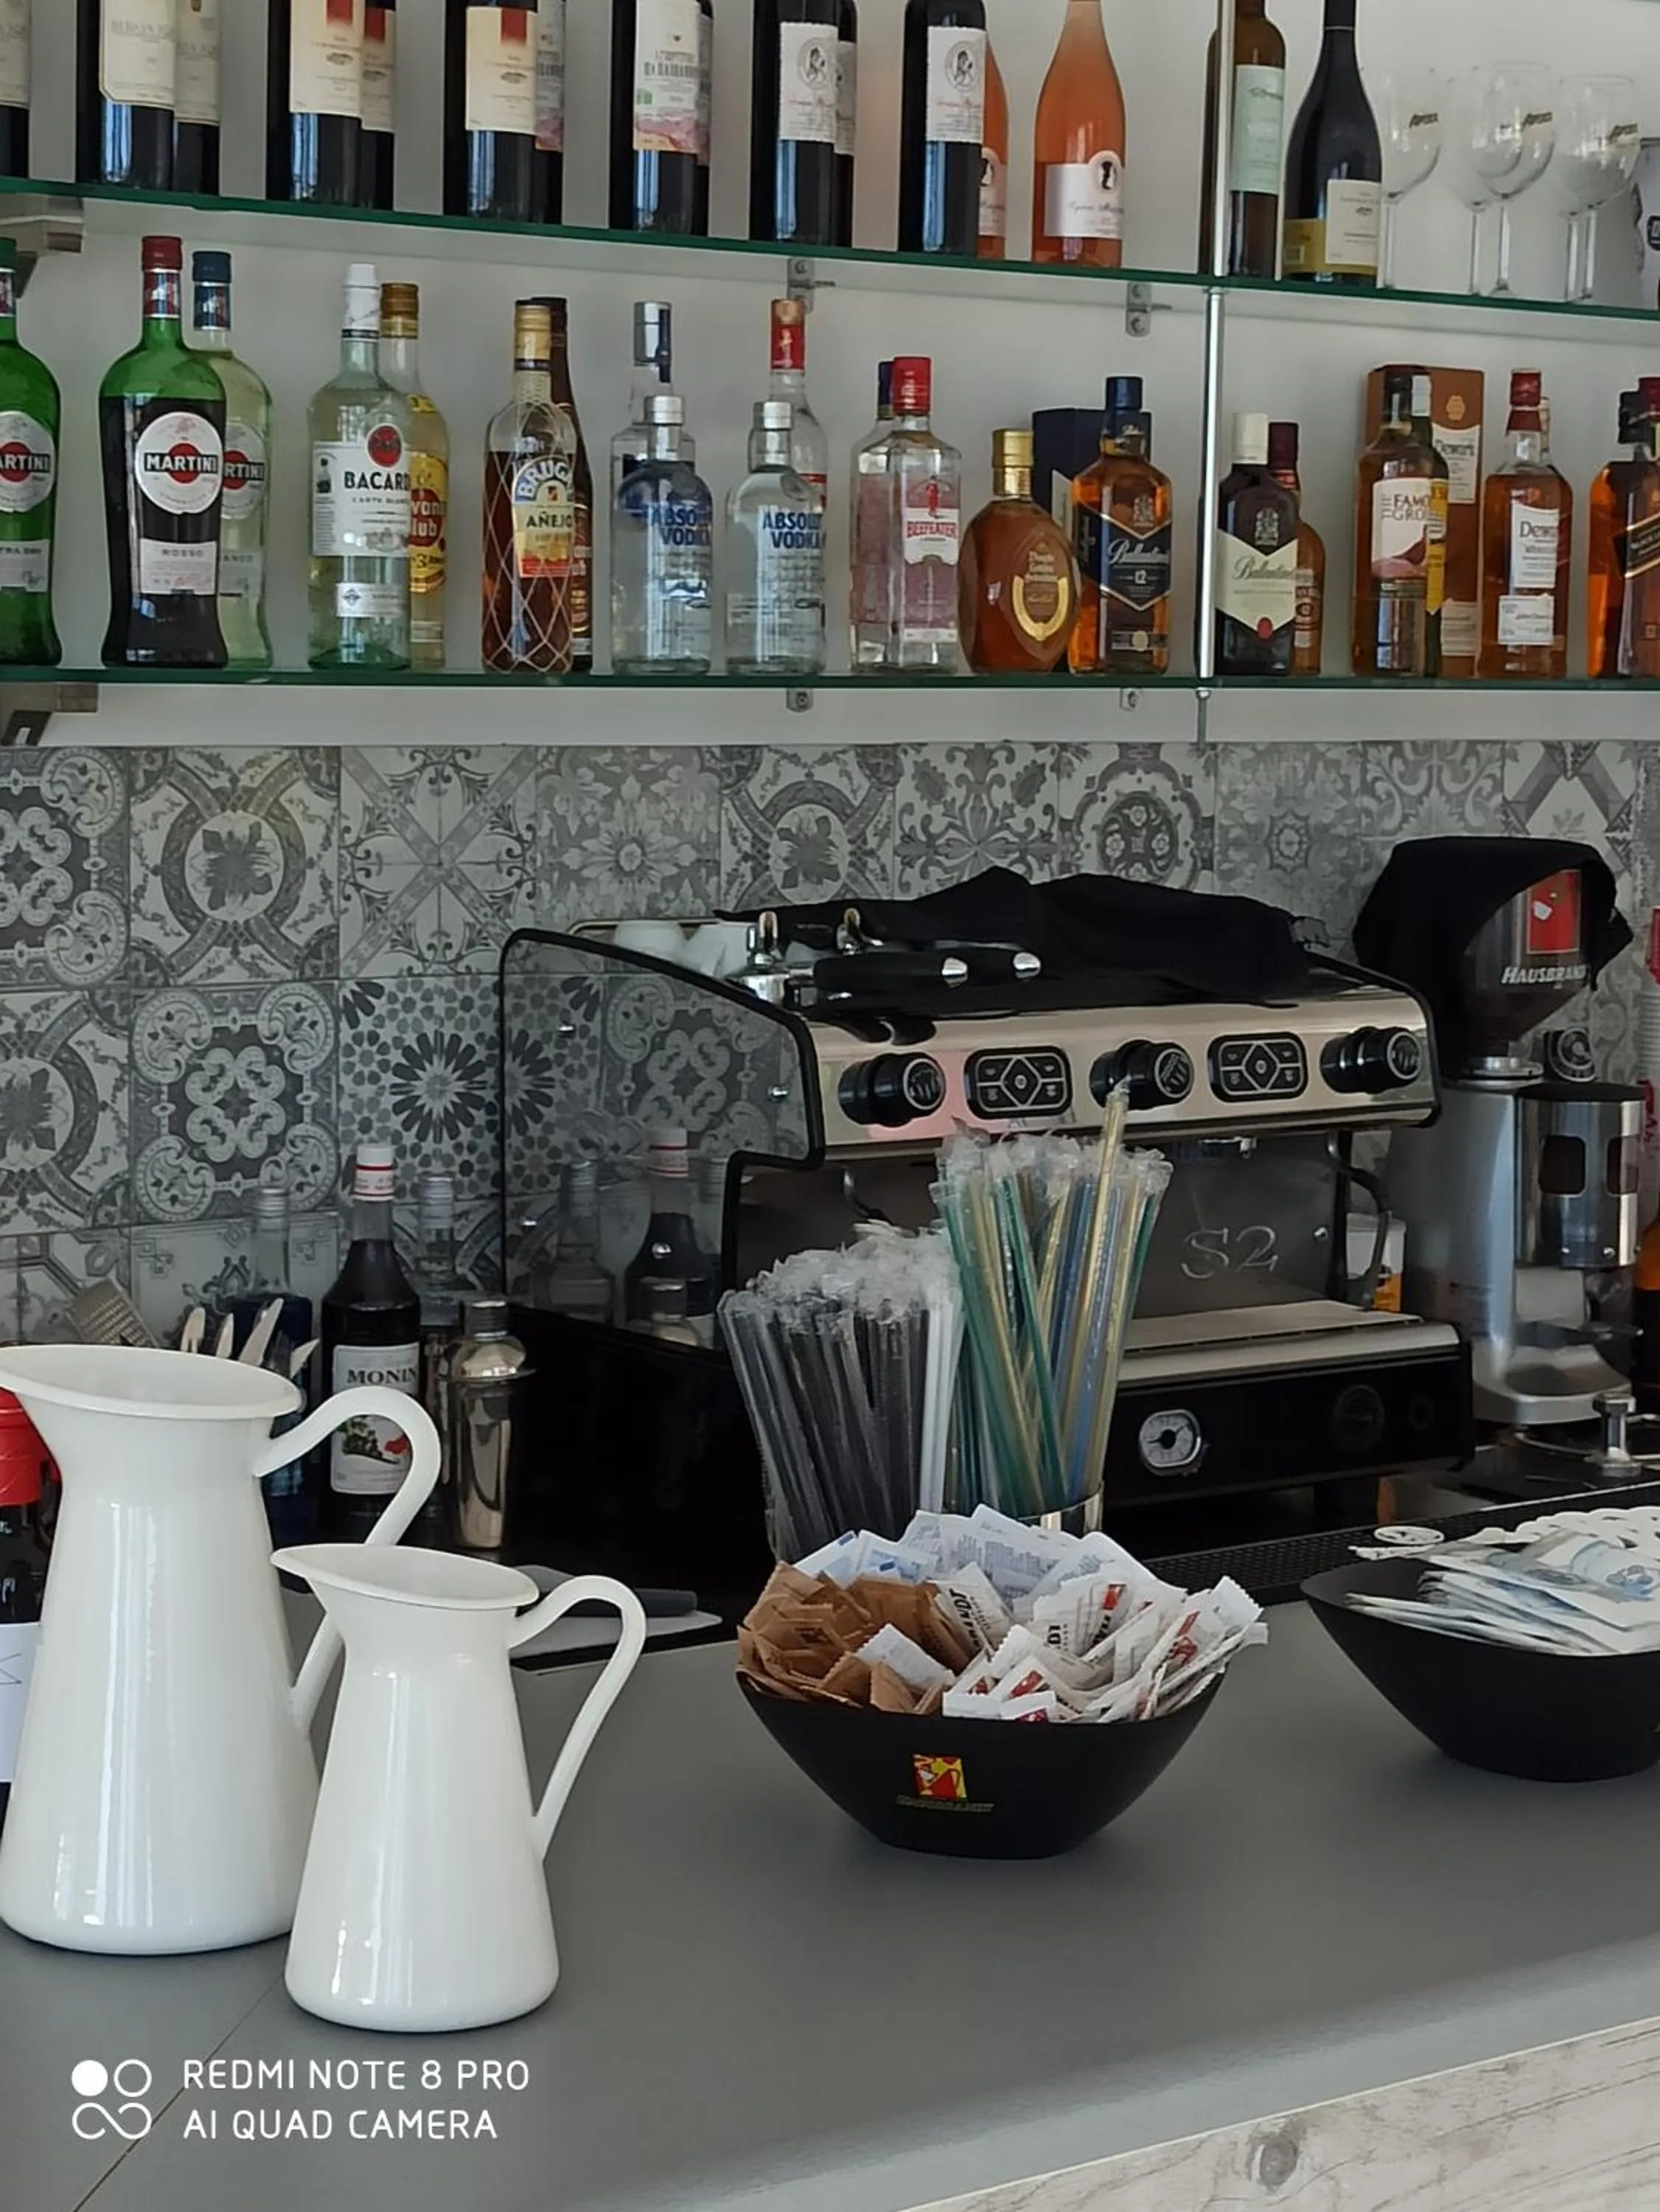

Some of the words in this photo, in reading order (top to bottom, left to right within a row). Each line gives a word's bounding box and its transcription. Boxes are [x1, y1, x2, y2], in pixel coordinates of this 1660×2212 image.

[0, 454, 49, 470] RTINI
[147, 454, 217, 472] MARTINI
[224, 463, 263, 479] RTINI
[517, 459, 571, 498] BRUG
[343, 470, 411, 492] BACARD
[411, 501, 441, 516] van
[1392, 508, 1426, 521] GRO
[411, 517, 438, 537] lub
[162, 548, 204, 557] ROSSO
[223, 554, 254, 563] ANCO
[1134, 570, 1147, 585] 12
[1181, 1225, 1279, 1279] S2
[346, 1368, 417, 1385] MONIN
